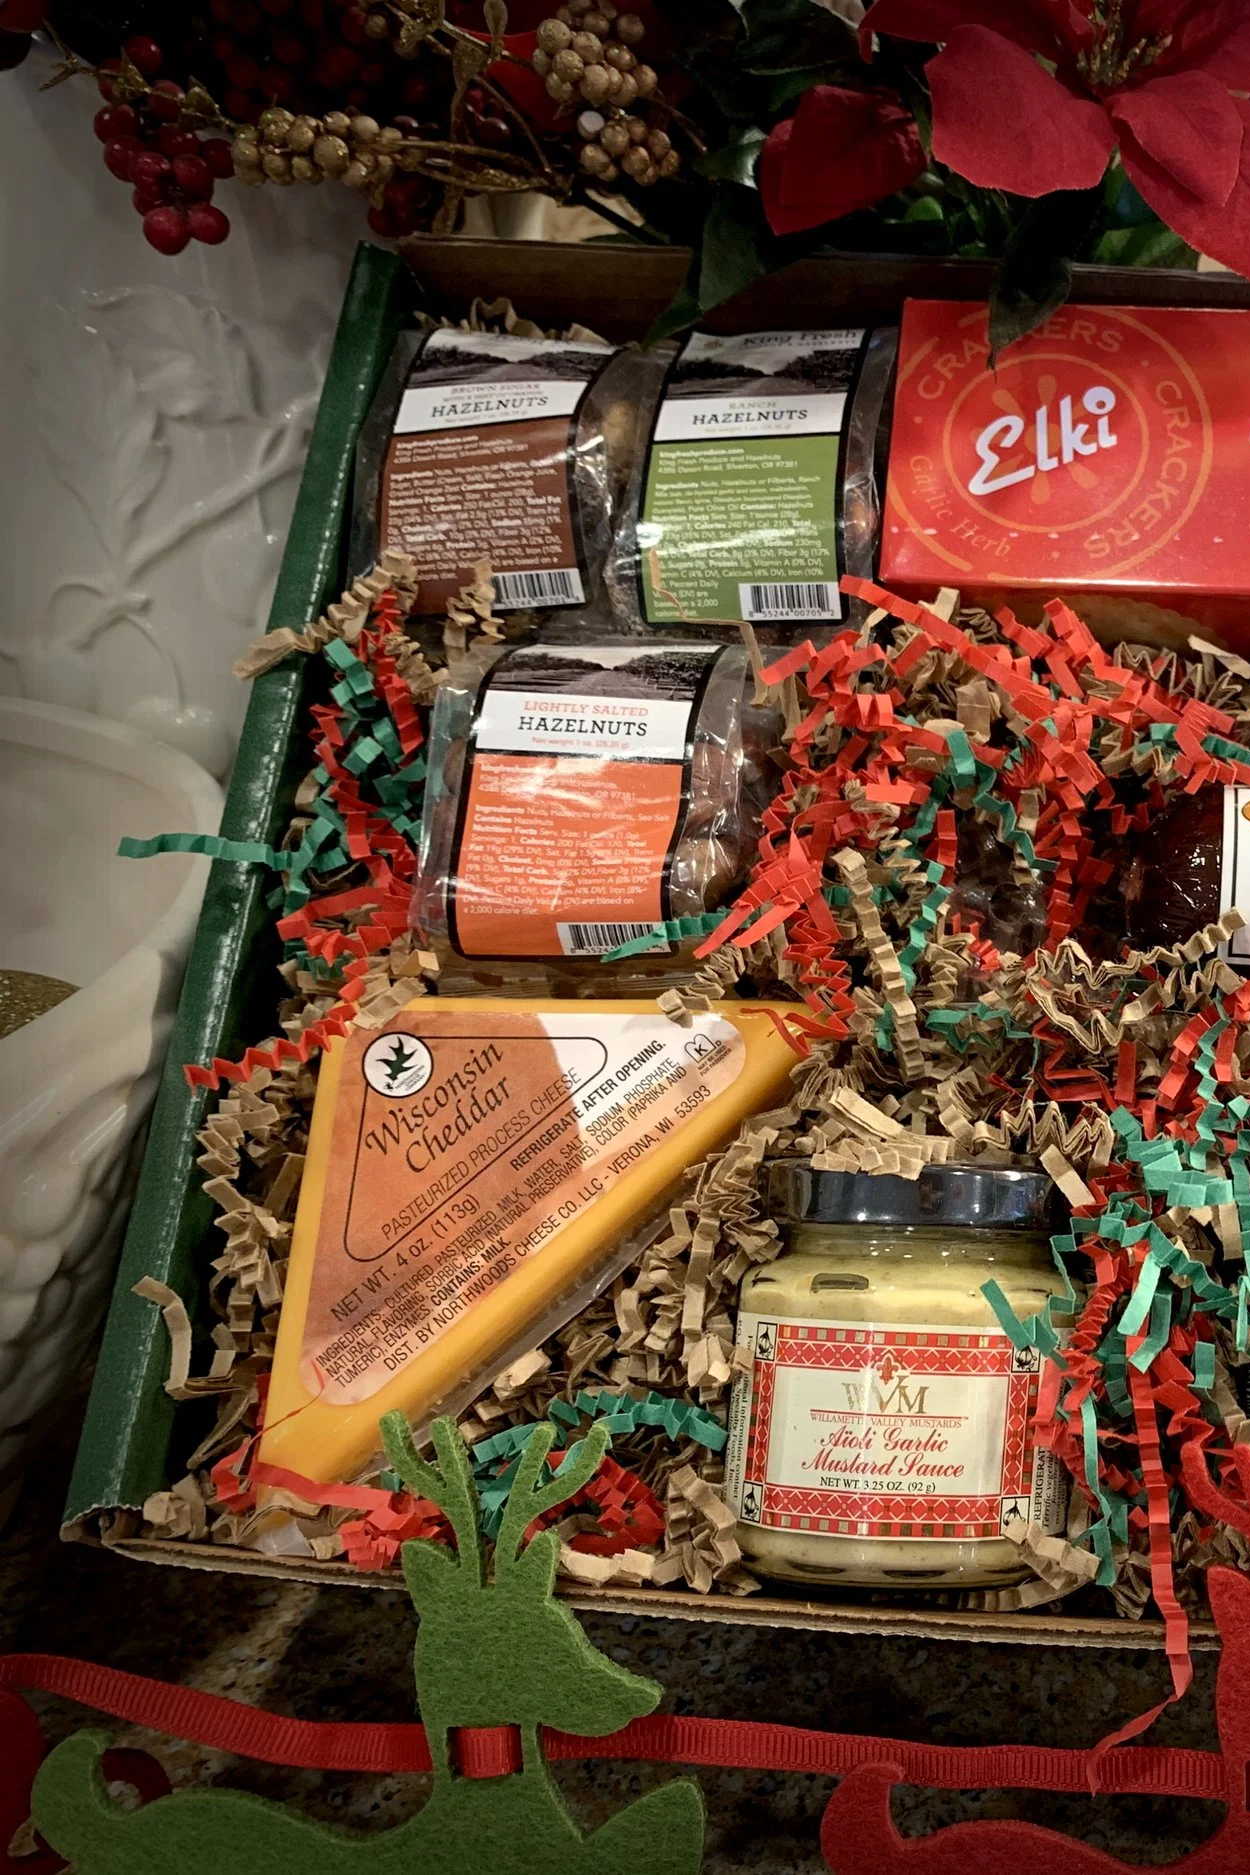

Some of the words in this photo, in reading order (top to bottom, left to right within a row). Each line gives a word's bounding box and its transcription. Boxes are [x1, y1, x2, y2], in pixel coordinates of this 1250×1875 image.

[917, 317, 1125, 400] CRAERS
[431, 396, 549, 418] HAZELNUTS
[692, 409, 808, 425] HAZELNUTS
[728, 401, 777, 410] RANCH
[968, 386, 1118, 496] Elki
[1084, 380, 1193, 560] CRACKERS
[518, 716, 648, 736] HAZELNUTS
[524, 701, 589, 713] LIGHTLY
[592, 704, 648, 717] SALTED
[693, 1042, 708, 1057] K
[365, 1043, 503, 1156] Wisconsin
[405, 1076, 511, 1173] Cheddar
[509, 1104, 584, 1172] REFRIGERATE
[579, 1076, 618, 1112] AFTER
[613, 1035, 667, 1083] OPENING.
[378, 1158, 472, 1242] PASTEURIZED
[466, 1107, 533, 1168] PROCESS
[526, 1065, 583, 1117] CHEESE
[315, 1305, 384, 1368] INGREDIENTS:
[382, 1261, 436, 1310] CULTURED
[433, 1208, 498, 1267] PASTEURIZED
[495, 1184, 527, 1214] MILK,
[522, 1154, 562, 1191] WATER,
[558, 1132, 588, 1161] SALT,
[584, 1100, 625, 1137] SODIUM
[622, 1054, 680, 1107] PHOSPHATE,
[324, 1334, 373, 1379] NATURAL
[369, 1286, 430, 1341] FLAVORING,
[424, 1256, 464, 1293] SORBIC
[458, 1236, 487, 1263] ACID
[482, 1199, 531, 1243] (NATURAL
[527, 1141, 600, 1206] PRESERVATIVE),
[594, 1114, 630, 1147] COLOR
[625, 1080, 670, 1121] (PAPRIKA
[663, 1064, 688, 1087] AND
[382, 1337, 419, 1372] DIST.
[414, 1321, 437, 1344] BY
[431, 1251, 518, 1329] NORTHWOODS
[512, 1213, 561, 1258] CHEESE
[556, 1195, 582, 1220] CO.
[577, 1176, 605, 1202] LLC
[607, 1129, 661, 1178] VERONA,
[654, 1115, 674, 1135] WI
[673, 1083, 712, 1119] 53593
[329, 1286, 367, 1323] NET
[391, 1251, 409, 1270] 4
[406, 1233, 434, 1259] oz.
[428, 1190, 482, 1241] (113g)
[334, 1340, 389, 1390] TUMERIC),
[429, 1256, 485, 1308] CONTAINS:
[479, 1233, 512, 1264] MILK.
[801, 1448, 898, 1476] Mustard
[898, 1452, 965, 1478] Sauce
[871, 1417, 907, 1426] VALLEY
[909, 1419, 962, 1428] MUSTARDS
[883, 1427, 949, 1452] Garlic
[820, 1477, 841, 1487] NET
[843, 1478, 860, 1489] WT.
[864, 1481, 884, 1490] 3.25
[886, 1482, 904, 1491] OZ.
